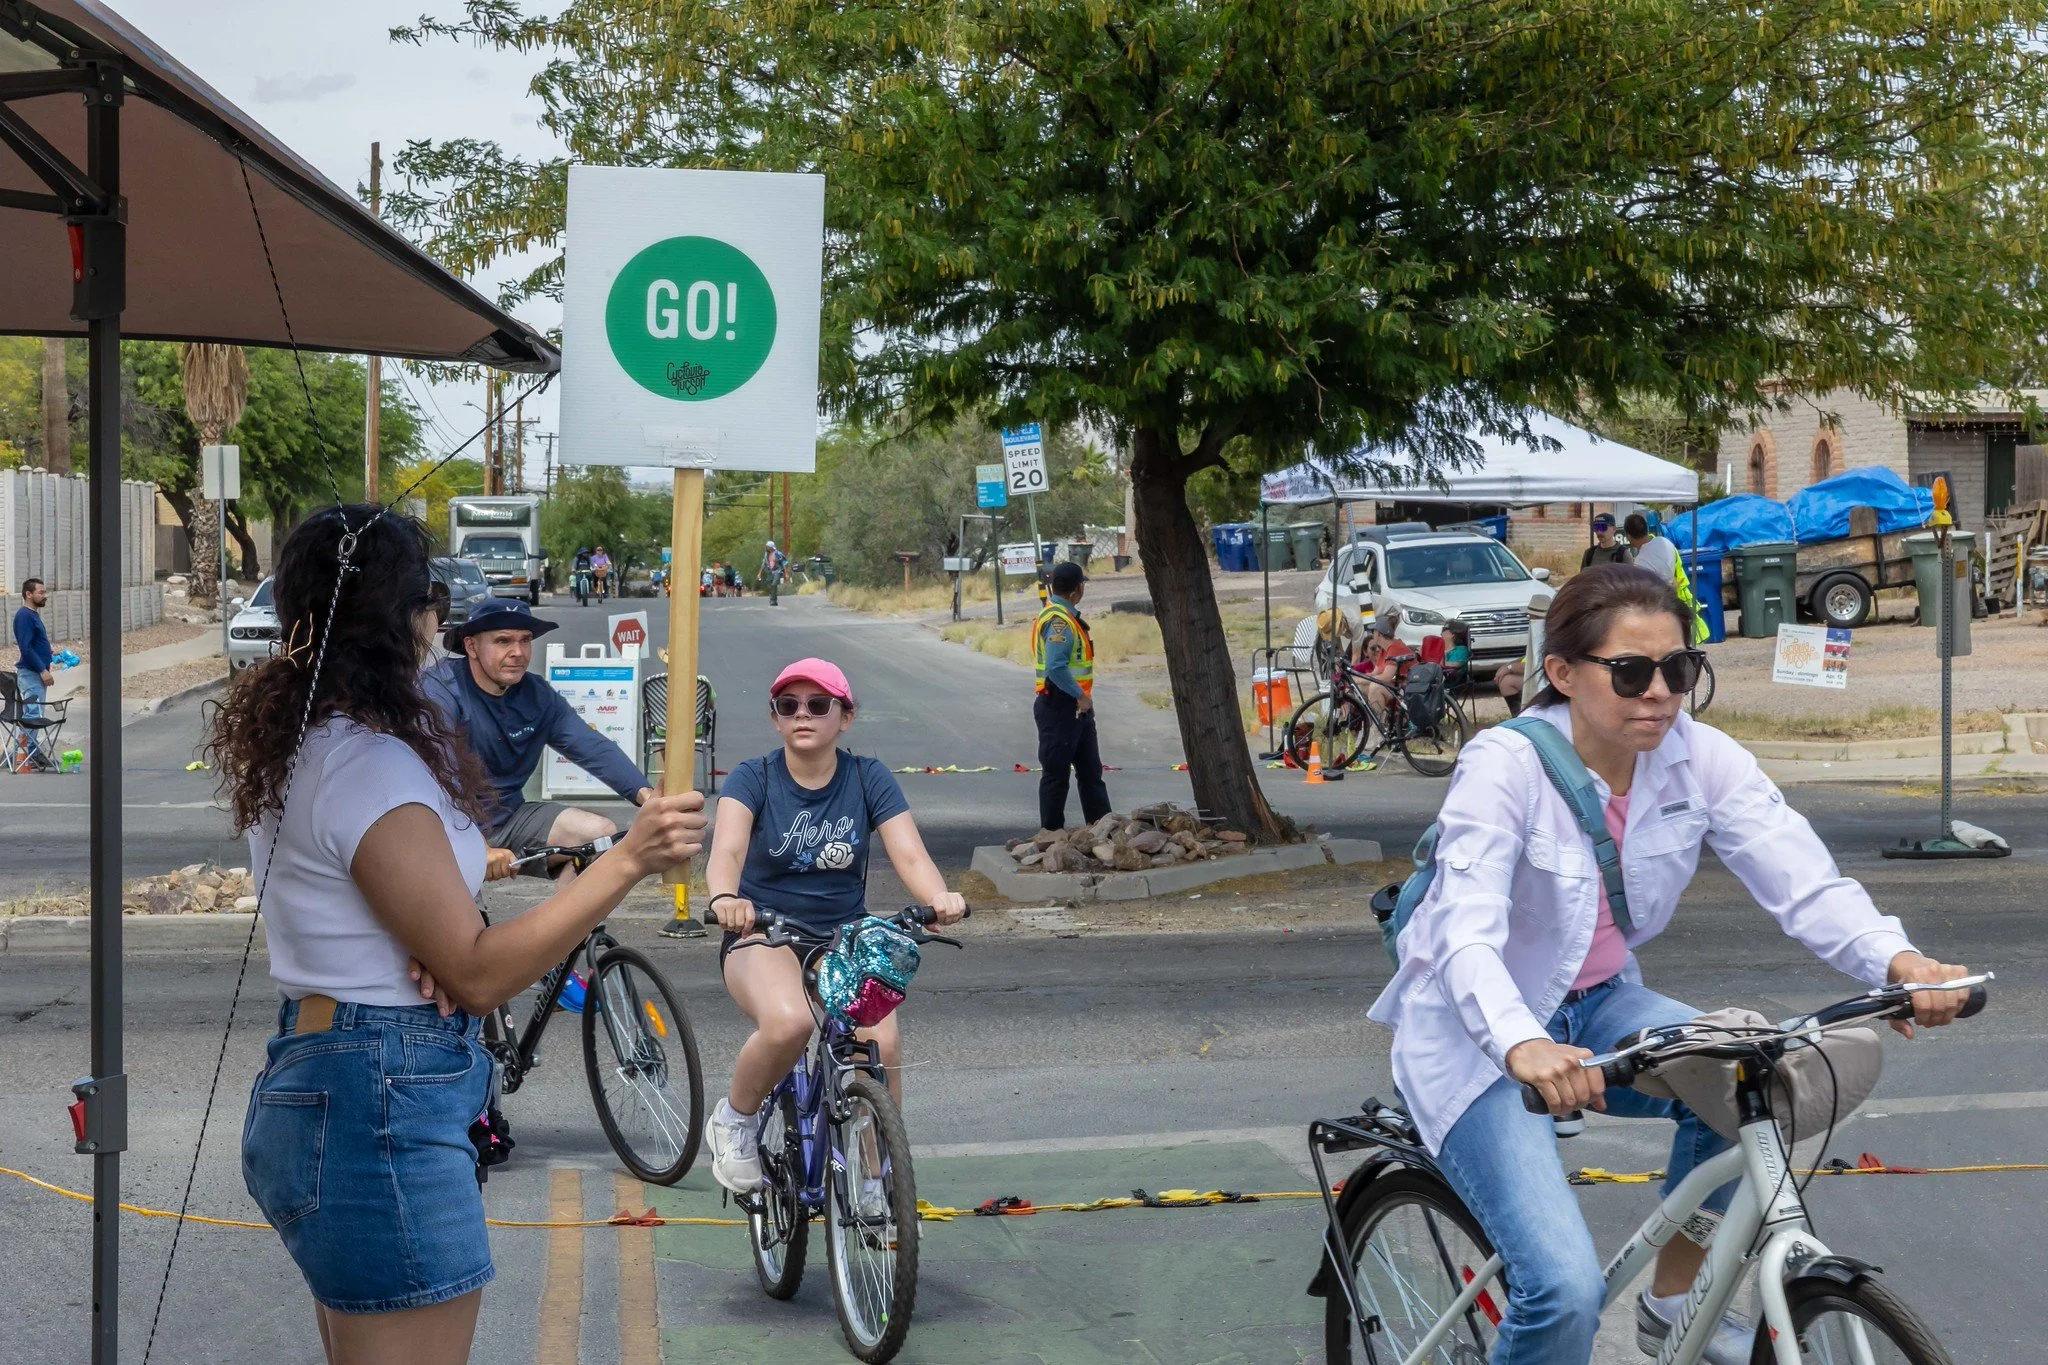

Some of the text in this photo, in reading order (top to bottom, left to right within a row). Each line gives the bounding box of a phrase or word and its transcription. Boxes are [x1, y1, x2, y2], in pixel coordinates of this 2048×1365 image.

[647, 279, 737, 341] GO!
[667, 362, 706, 384] Cyclovia
[1004, 434, 1040, 444] BOULEVARD
[1008, 447, 1040, 459] SPEED
[1012, 459, 1039, 469] LIMIT
[1012, 469, 1043, 490] 20
[617, 629, 640, 643] WAIT
[769, 810, 854, 857] Aero
